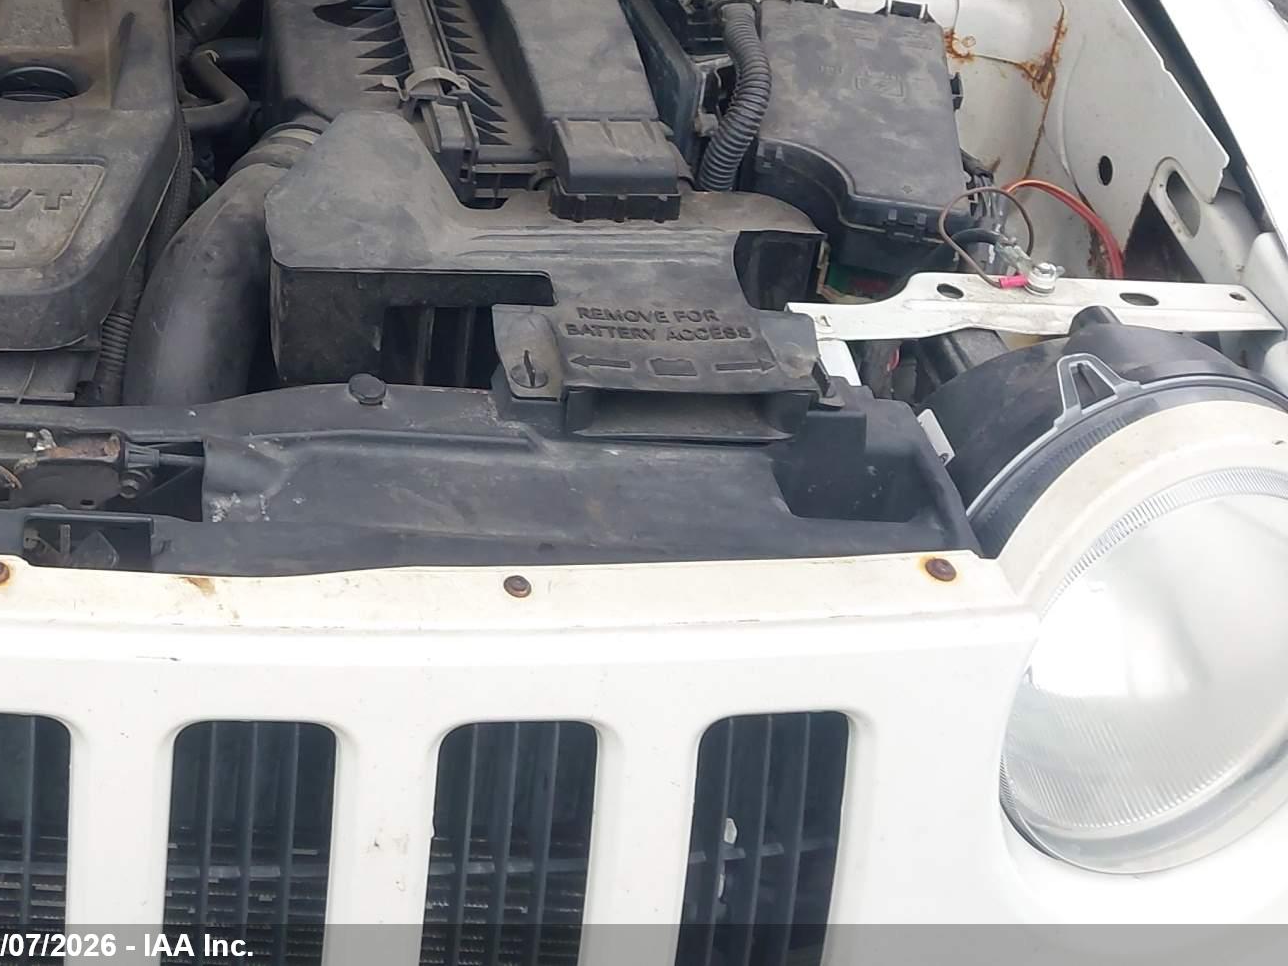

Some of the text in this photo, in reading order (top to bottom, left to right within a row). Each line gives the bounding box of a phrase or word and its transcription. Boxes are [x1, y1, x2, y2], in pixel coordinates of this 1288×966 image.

[575, 306, 720, 323] REMOVE FOR
[565, 323, 752, 341] BATTERY ACCESS
